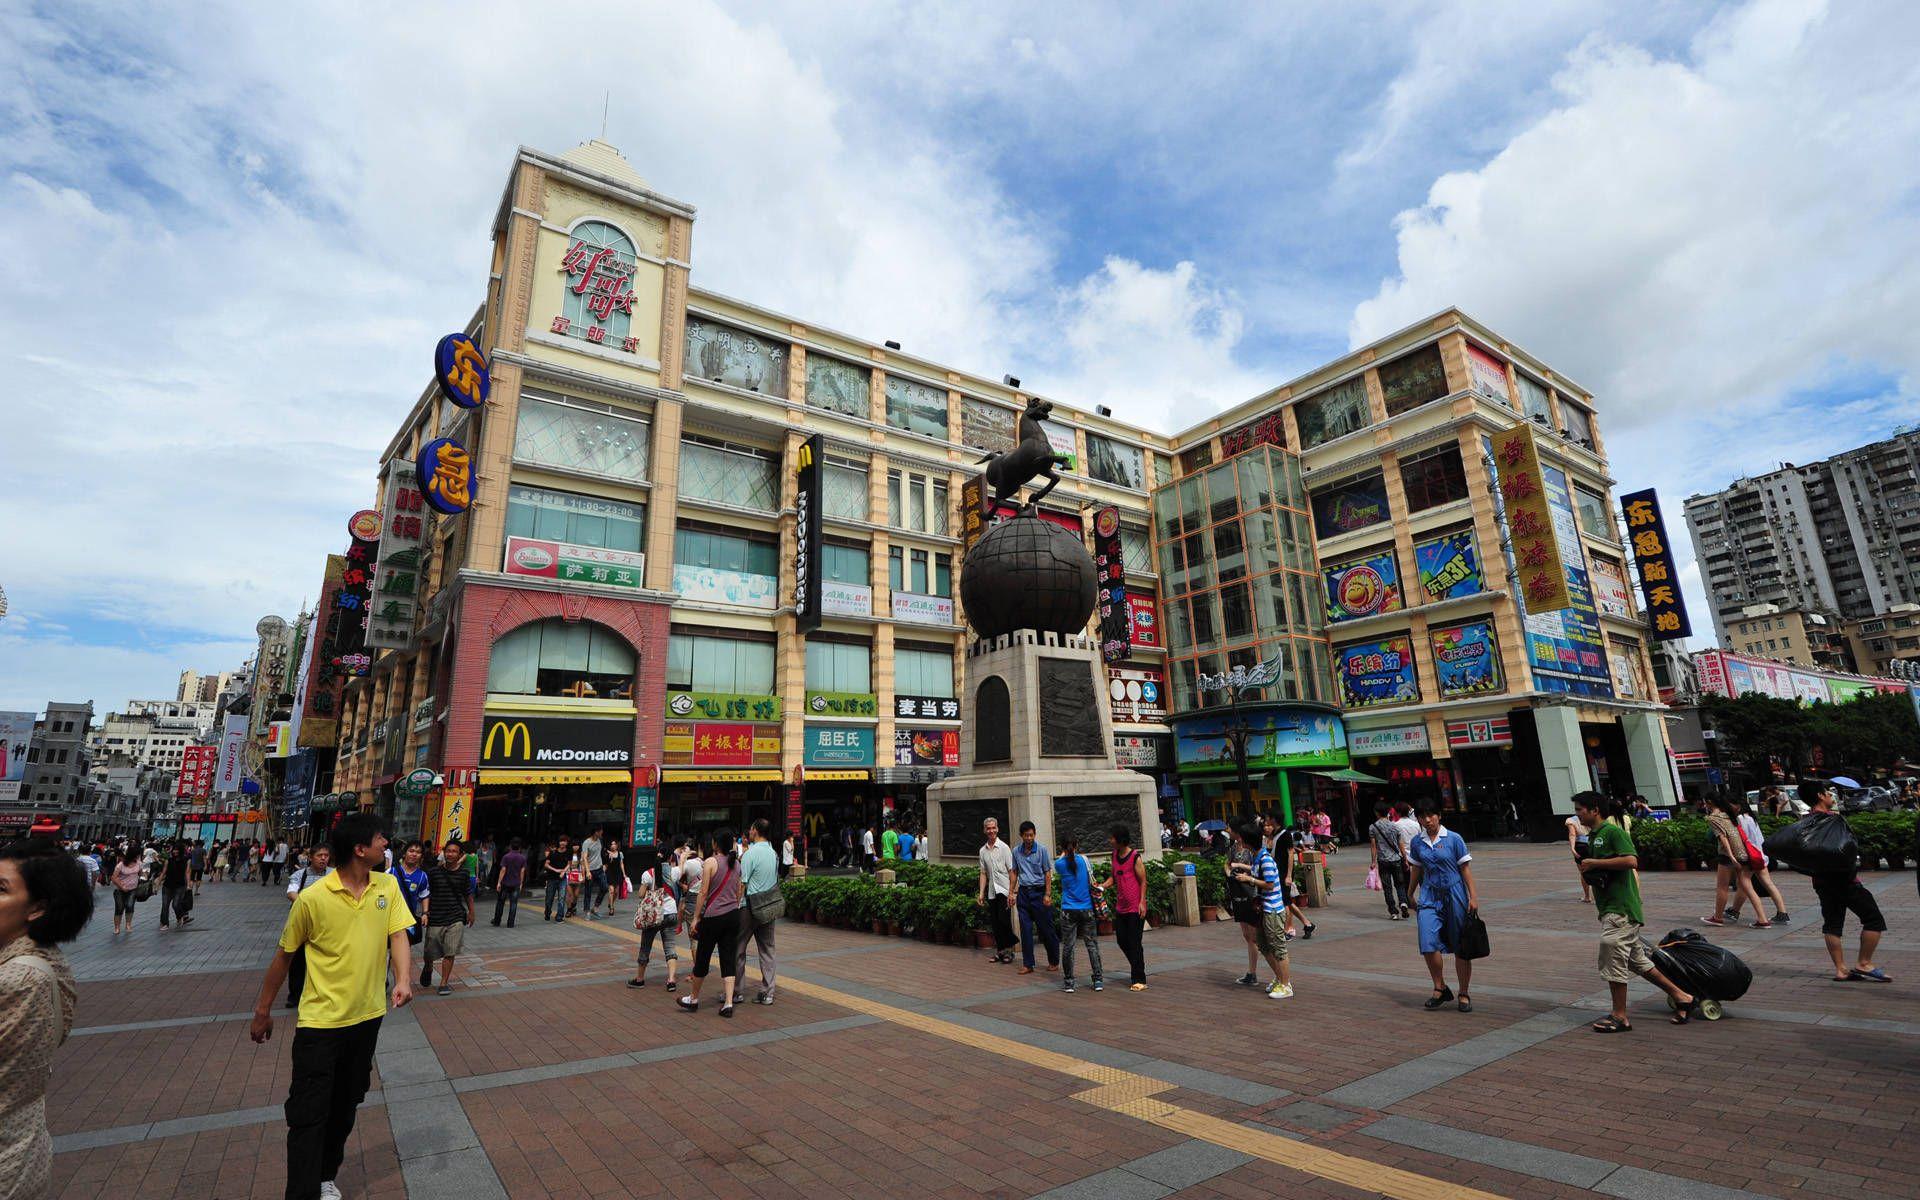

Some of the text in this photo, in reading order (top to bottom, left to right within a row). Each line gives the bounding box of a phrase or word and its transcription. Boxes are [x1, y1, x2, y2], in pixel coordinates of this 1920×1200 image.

[566, 564, 633, 584] 萨莉亚
[1626, 500, 1680, 632] 东急新天地
[1349, 652, 1401, 676] 乐缤纷
[898, 698, 959, 718] 麦当劳
[818, 731, 860, 747] 屈臣氏
[895, 729, 912, 740] 天天
[536, 749, 629, 761] McDonald's
[634, 796, 649, 842] 屈臣氏
